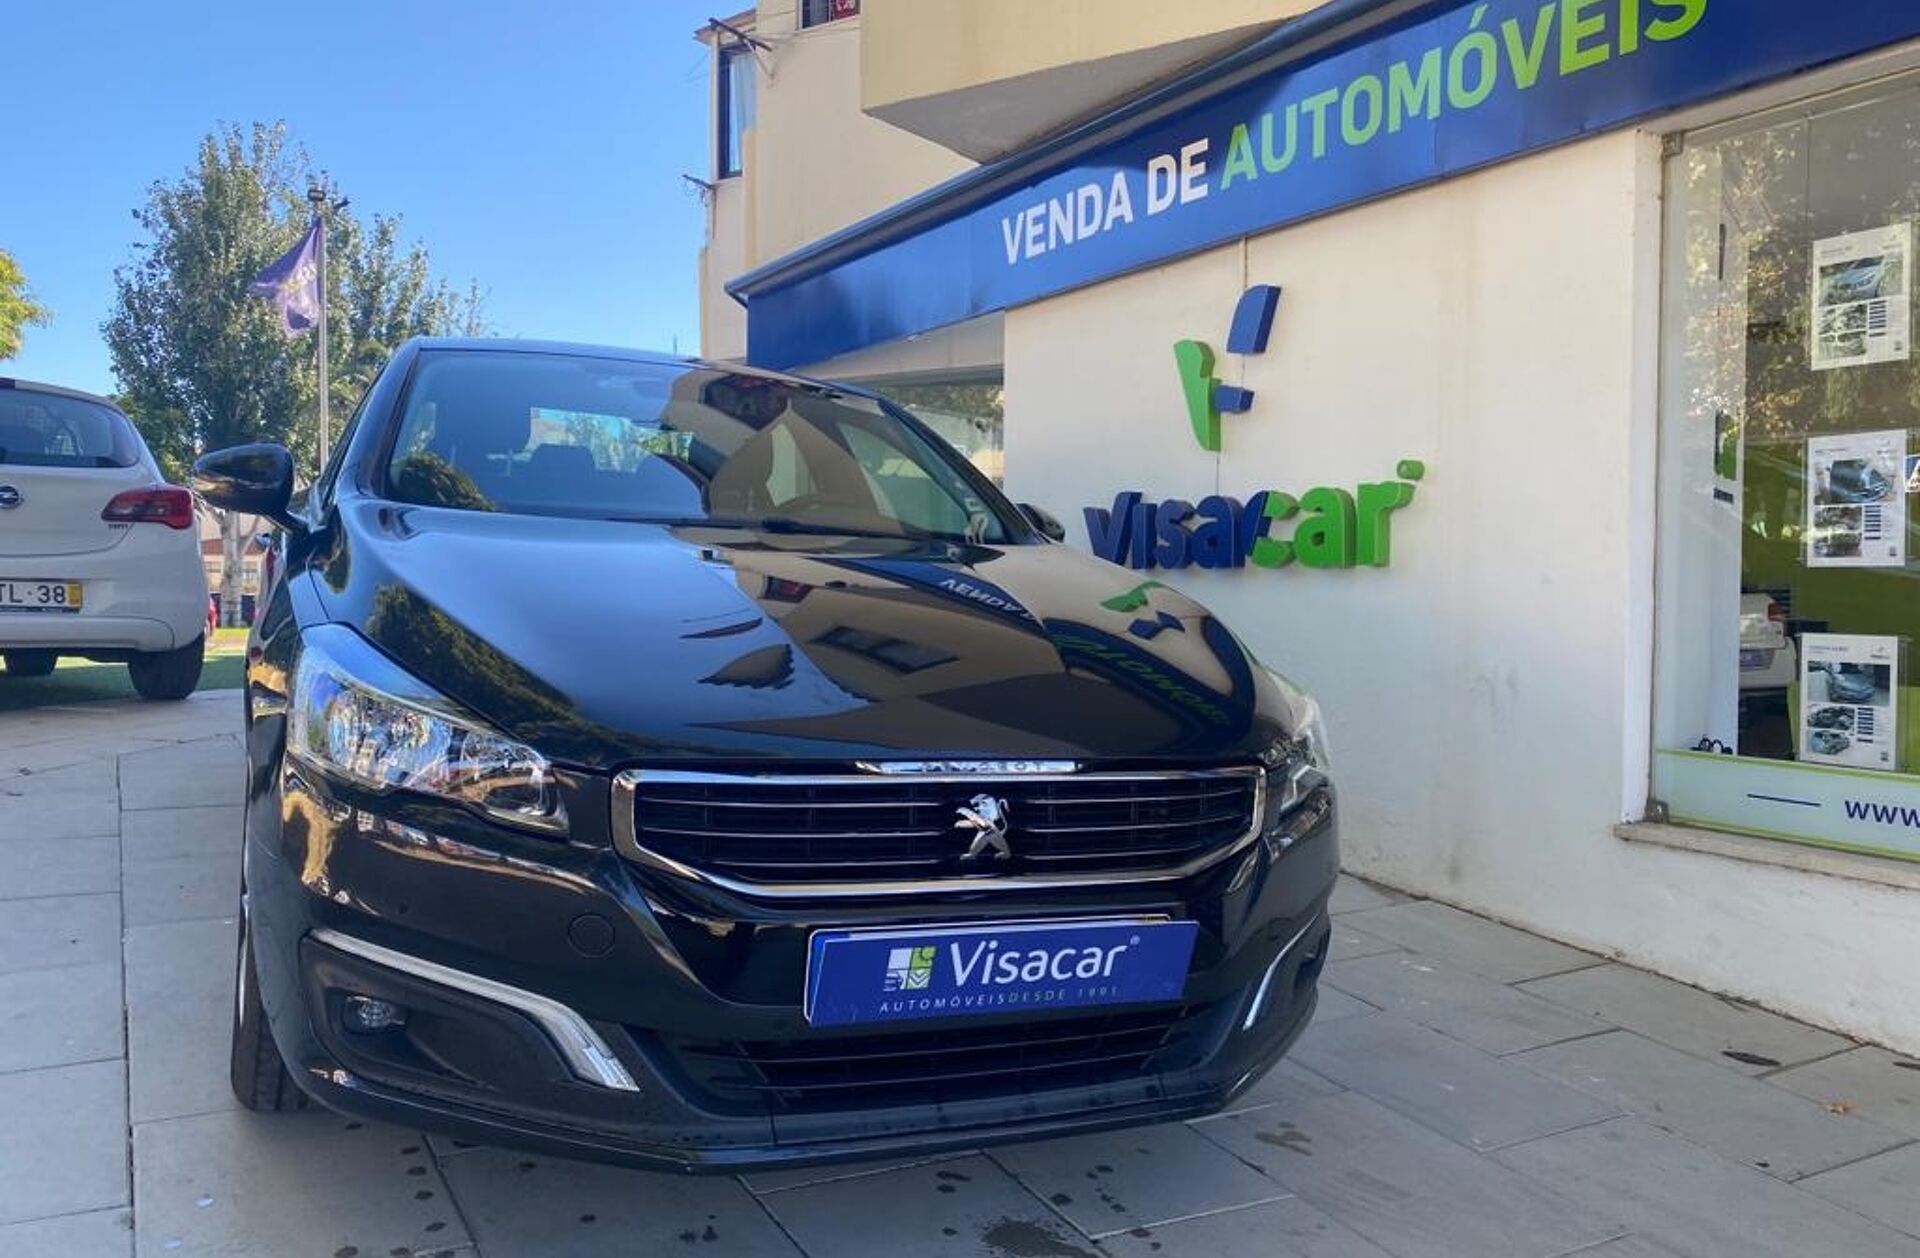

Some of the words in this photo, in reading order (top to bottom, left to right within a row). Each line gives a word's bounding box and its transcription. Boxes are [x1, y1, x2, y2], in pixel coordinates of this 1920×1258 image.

[1001, 171, 1134, 266] VENDA
[1147, 137, 1210, 216] DE
[950, 939, 1128, 987] Visacar
